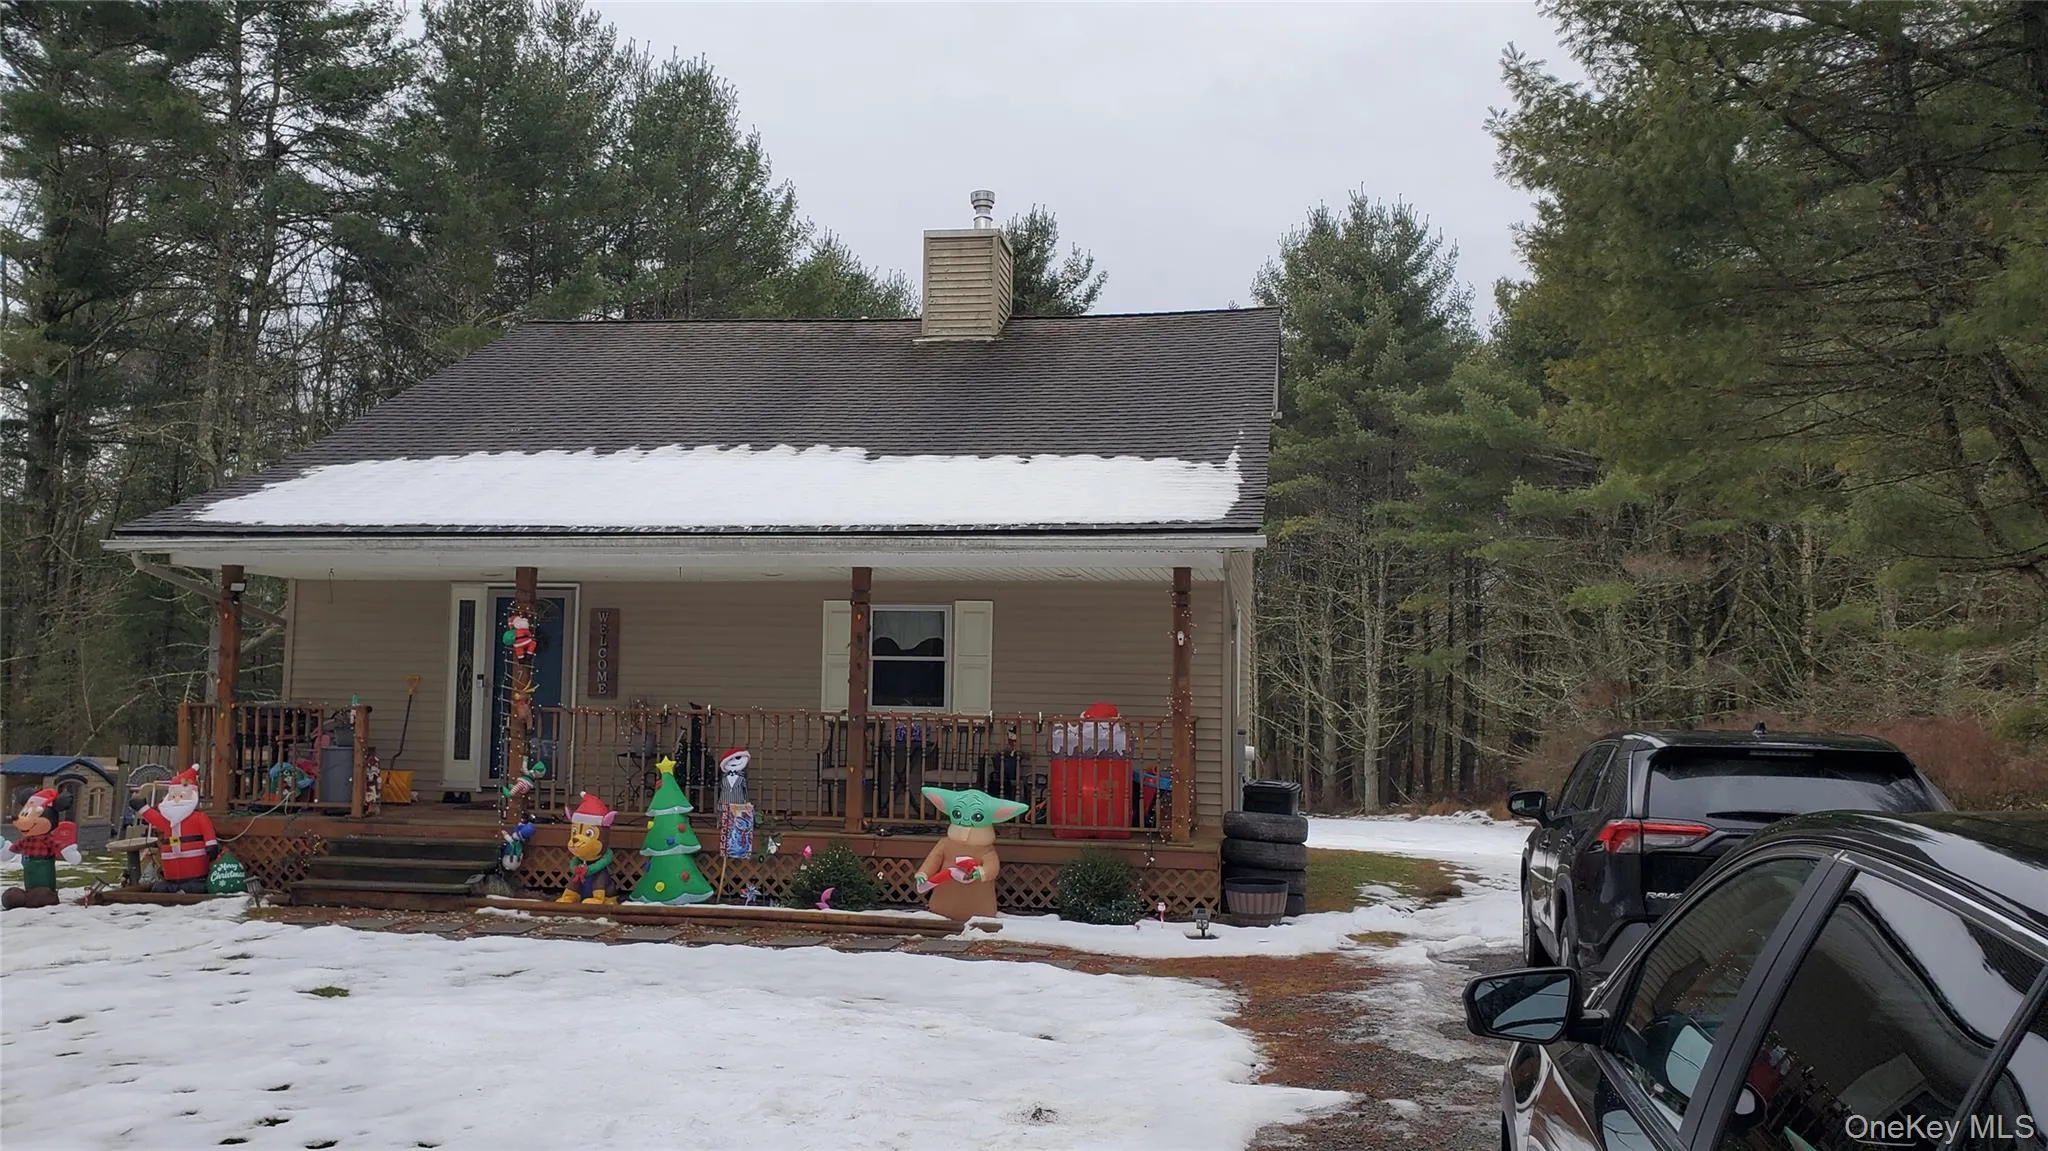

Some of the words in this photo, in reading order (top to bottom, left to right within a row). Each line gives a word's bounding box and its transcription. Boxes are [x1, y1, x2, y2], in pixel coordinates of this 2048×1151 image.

[597, 611, 609, 694] WELCOME
[217, 862, 239, 871] Merry
[210, 870, 245, 882] Christmas
